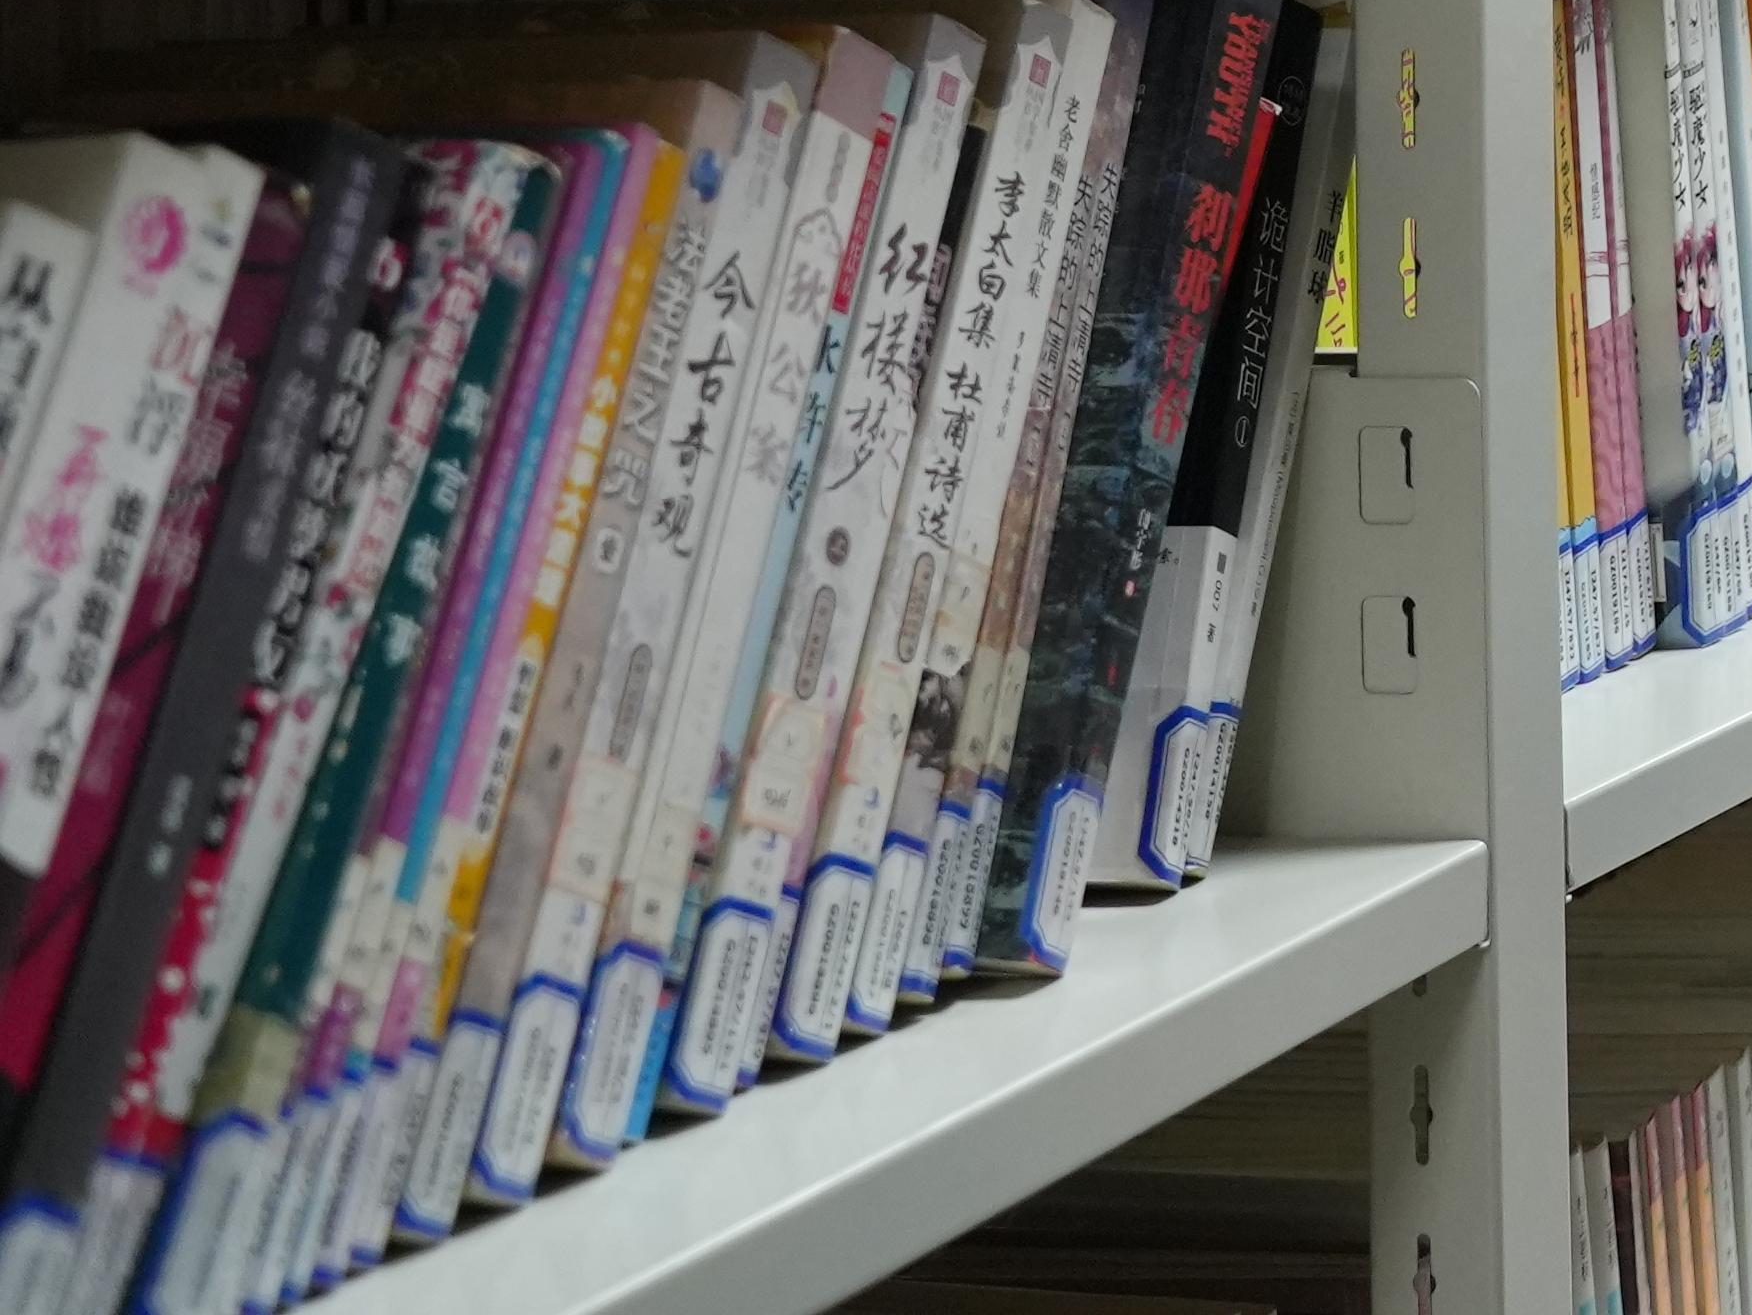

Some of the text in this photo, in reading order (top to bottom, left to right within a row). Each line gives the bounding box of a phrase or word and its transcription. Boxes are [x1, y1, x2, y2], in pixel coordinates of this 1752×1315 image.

[825, 223, 931, 492] 红楼梦
[958, 170, 1025, 350] 李太白集
[1236, 196, 1291, 411] 诡计空间
[648, 251, 757, 559] 今古奇观
[916, 361, 984, 551] 杜甫诗选
